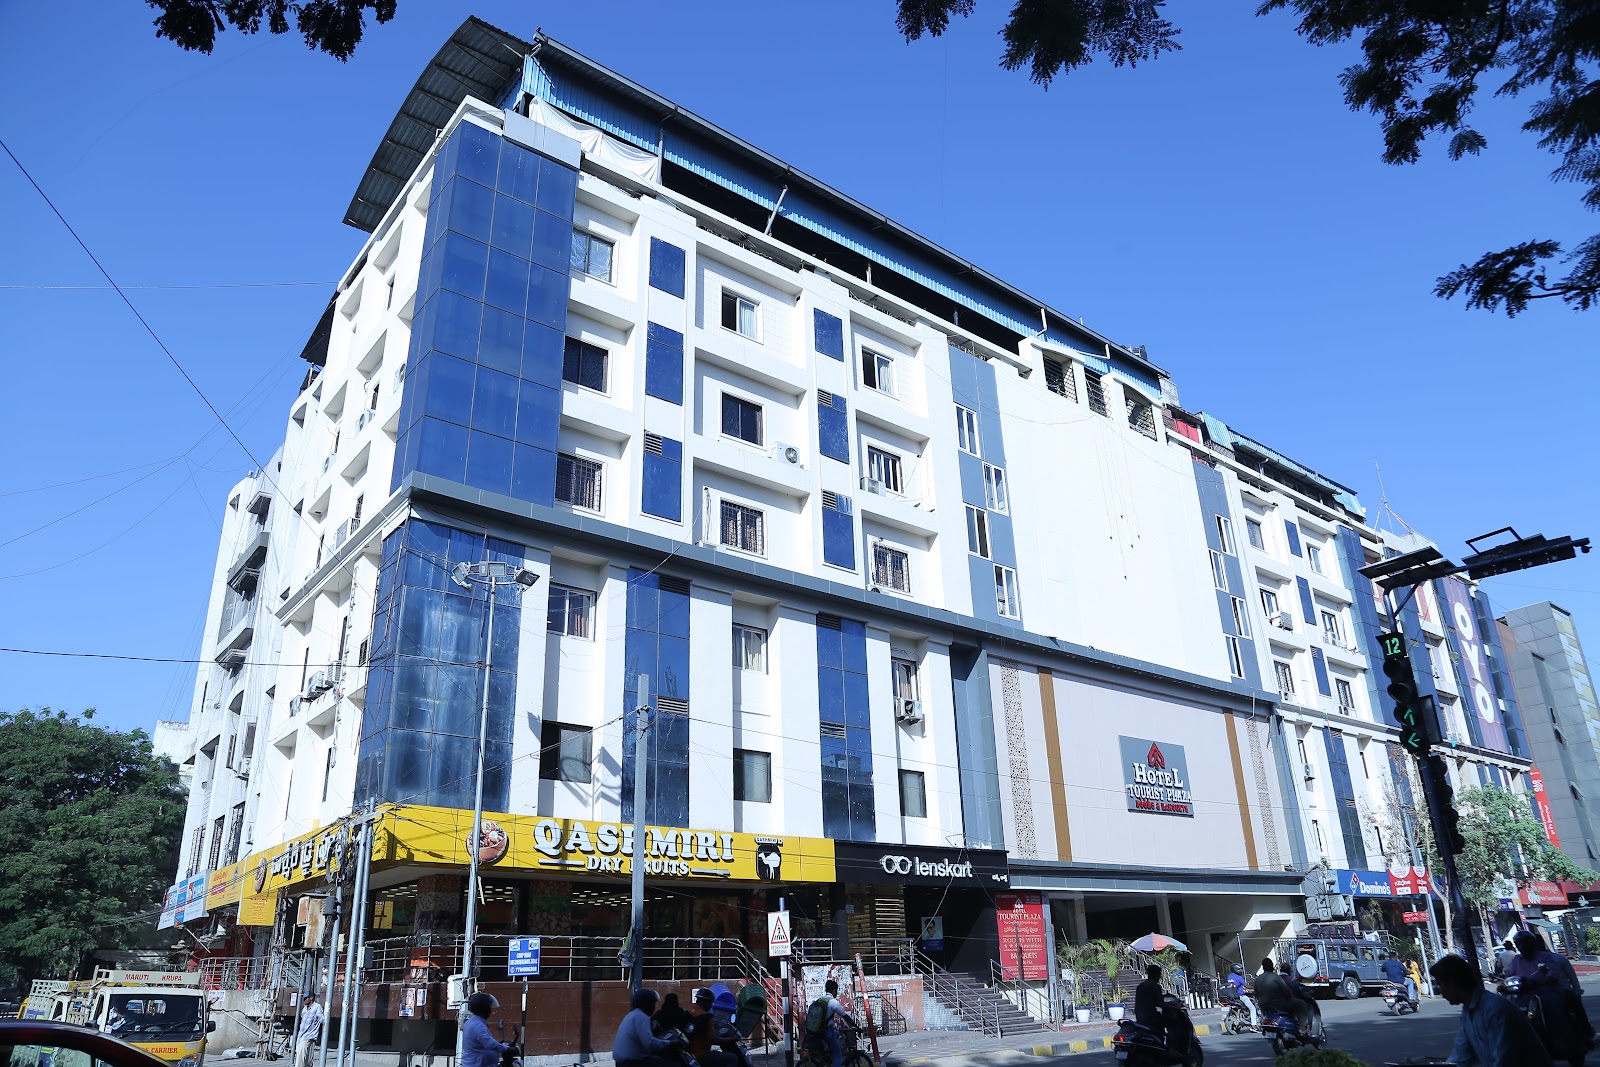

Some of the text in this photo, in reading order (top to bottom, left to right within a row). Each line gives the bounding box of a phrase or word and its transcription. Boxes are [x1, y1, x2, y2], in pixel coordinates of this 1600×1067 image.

[1385, 638, 1400, 656] 12
[1454, 602, 1495, 723] OYO
[1126, 784, 1192, 803] TOURIST PLAZA
[533, 819, 734, 861] QASHMIRI
[587, 856, 623, 873] DRY
[914, 856, 973, 878] lenskart
[1360, 881, 1391, 895] Domino's
